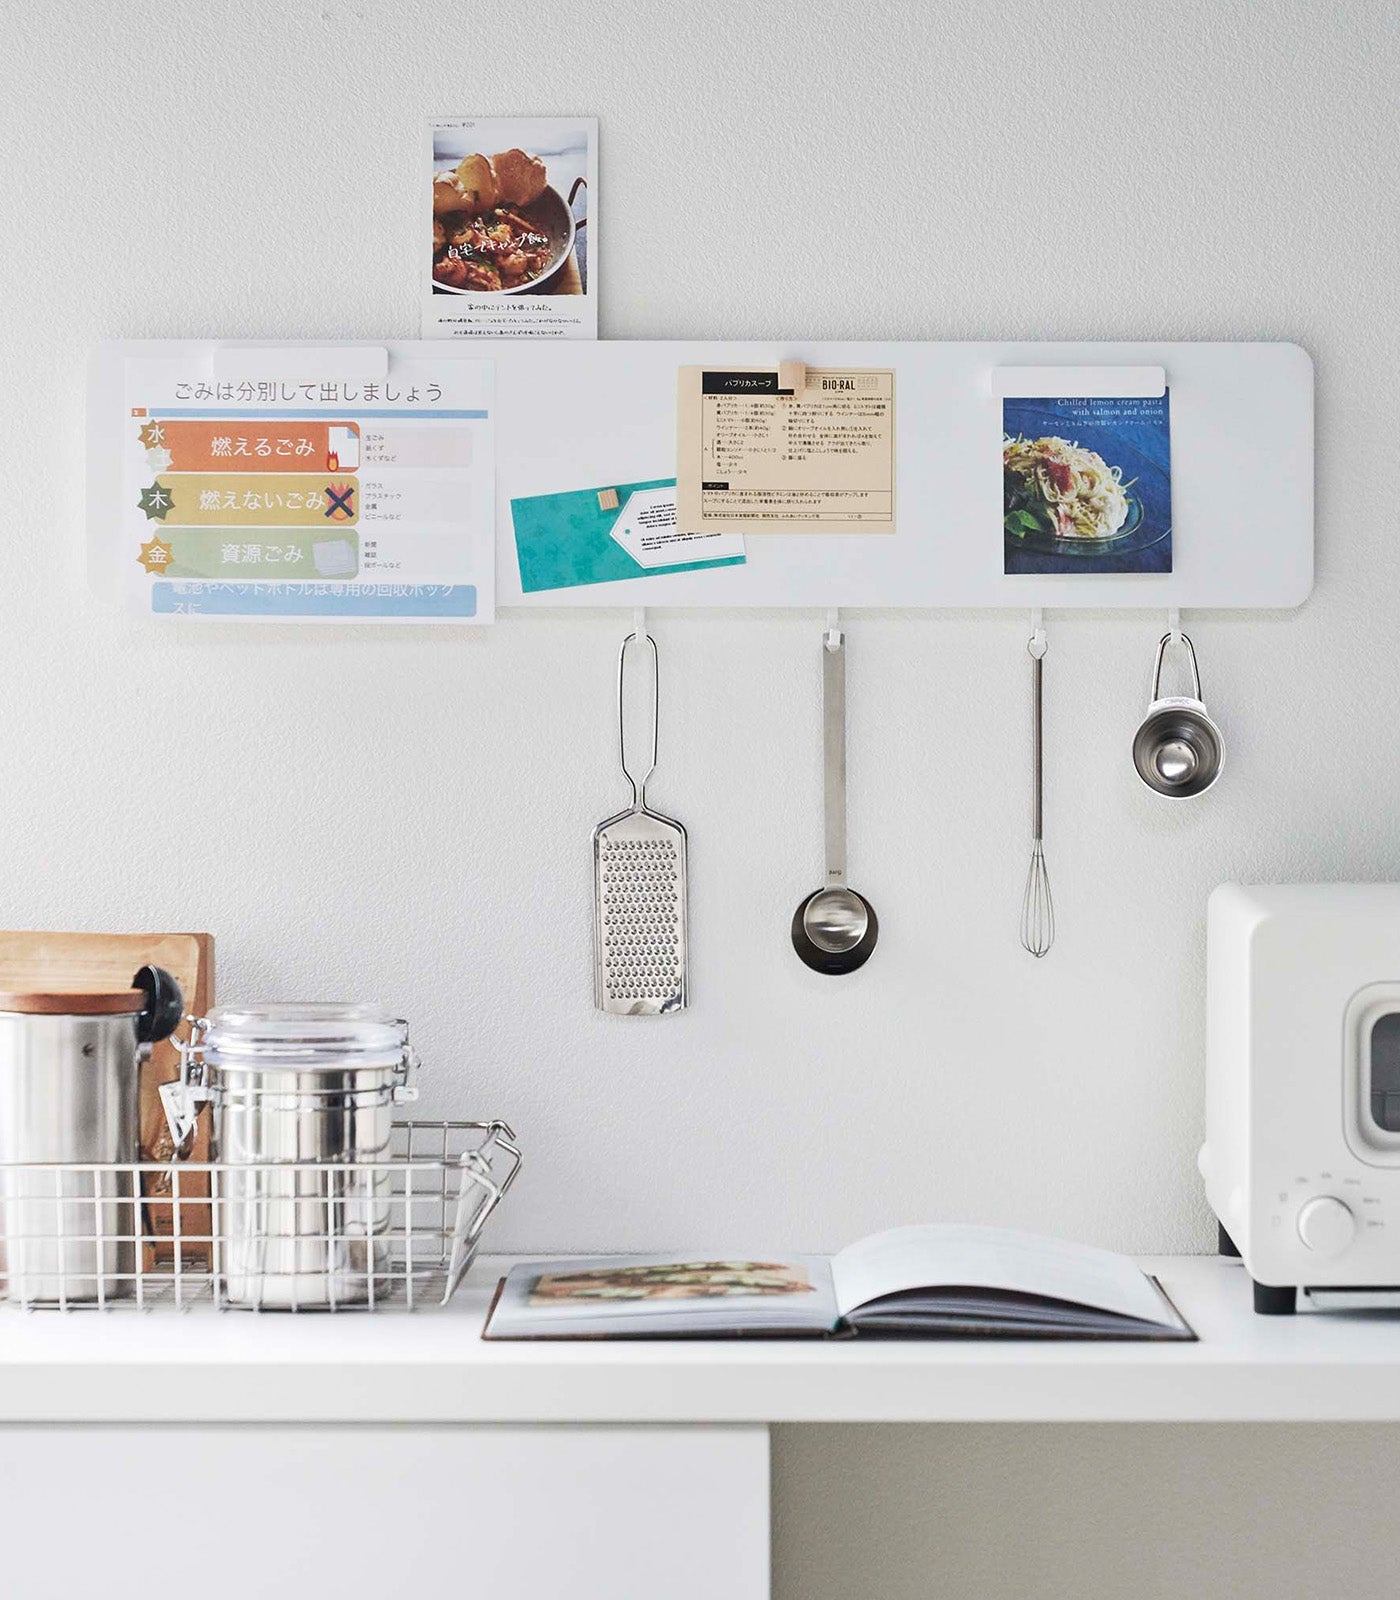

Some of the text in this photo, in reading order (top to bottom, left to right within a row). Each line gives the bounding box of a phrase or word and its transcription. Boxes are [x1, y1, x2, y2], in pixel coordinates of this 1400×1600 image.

[175, 381, 442, 403] ごみは分別して出しましょう
[1057, 399, 1087, 407] Chilled
[1143, 400, 1163, 408] pasta
[1072, 408, 1164, 416] with salmon and onion
[147, 424, 165, 444] 水
[210, 436, 315, 457] 燃えるごみ
[148, 491, 168, 509] 木
[199, 489, 326, 511] 燃えないごみ
[147, 544, 168, 565] 金
[220, 543, 304, 564] 資源ごみ
